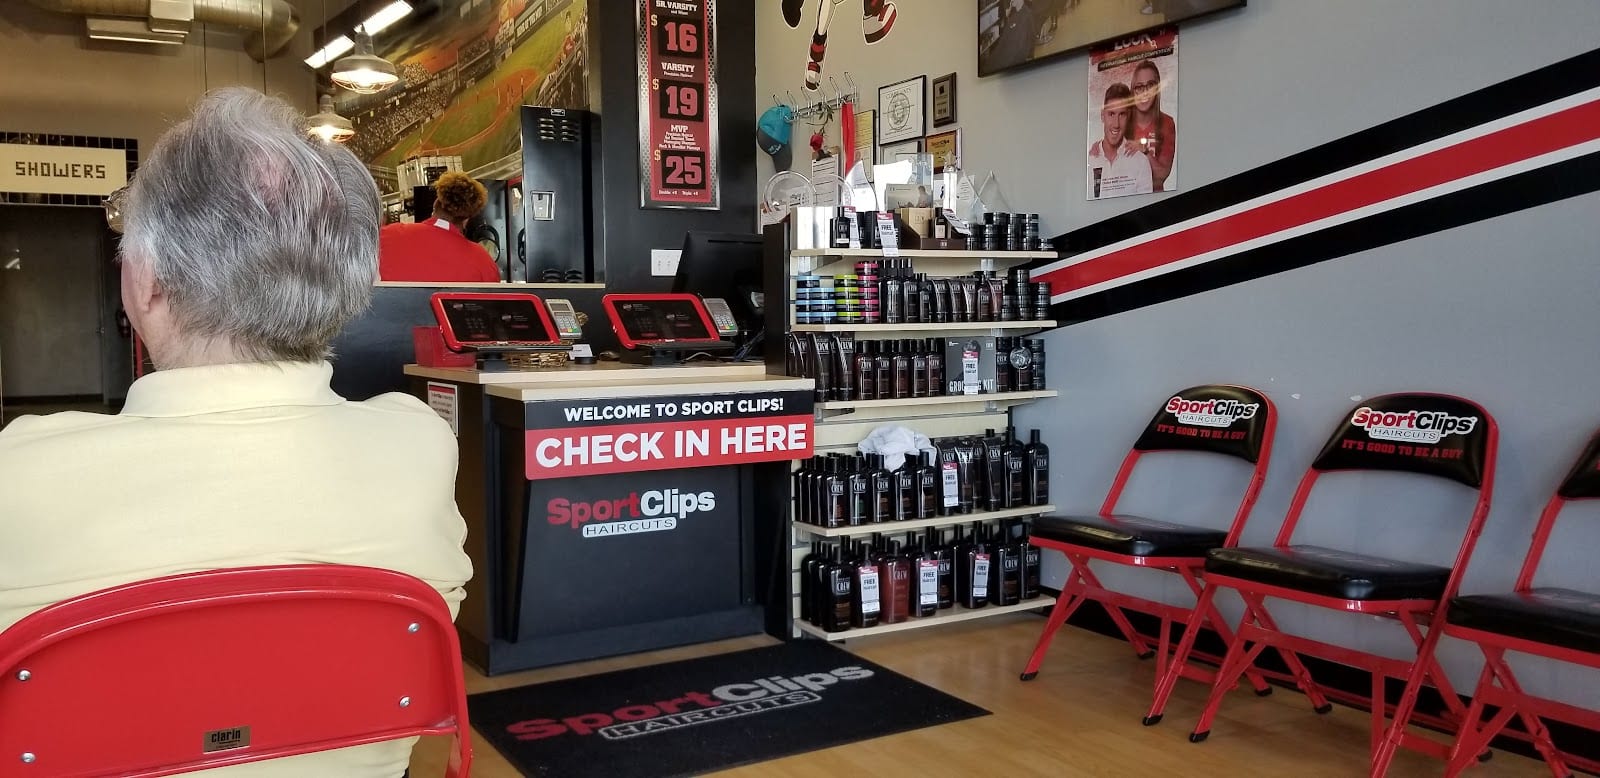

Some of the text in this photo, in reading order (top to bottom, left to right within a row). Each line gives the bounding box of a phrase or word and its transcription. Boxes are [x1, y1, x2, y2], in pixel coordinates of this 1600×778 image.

[667, 1, 698, 12] VARSITY
[650, 14, 697, 53] $ 16
[661, 62, 695, 72] VARSITY
[652, 78, 698, 116] $ 19
[670, 124, 689, 133] MVP
[15, 161, 106, 179] SHOWERS
[654, 149, 702, 185] $ 25
[840, 341, 853, 350] CREW
[983, 379, 994, 391] KIT
[564, 398, 784, 422] WELCOME TO SPORT CLIPS!
[1167, 397, 1258, 420] SportClips
[1181, 414, 1229, 425] HAIRCUTS
[1353, 409, 1474, 435] SportClips
[1156, 423, 1246, 440] IT'S GOOD TO BE A GUY
[1373, 428, 1438, 440] HAIRCUTS
[535, 423, 807, 468] CHECK IN HERE
[1342, 439, 1464, 459] IT'S GOOD TO BE A GUY
[959, 450, 973, 461] CREW
[1010, 460, 1022, 470] CREW
[853, 482, 866, 491] CREW
[877, 482, 889, 490] CREW
[900, 478, 912, 486] CREW
[922, 476, 934, 485] CREW
[831, 484, 844, 494] CREW
[546, 488, 716, 528] SportClips
[585, 518, 674, 536] HAIRCUTS
[1004, 559, 1018, 569] CREW
[922, 571, 935, 579] FREE
[836, 582, 850, 591] CREW
[863, 578, 876, 586] FREE
[505, 665, 875, 741] SportClips
[612, 692, 811, 737] HAIRCUTS
[211, 729, 241, 743] clarin
